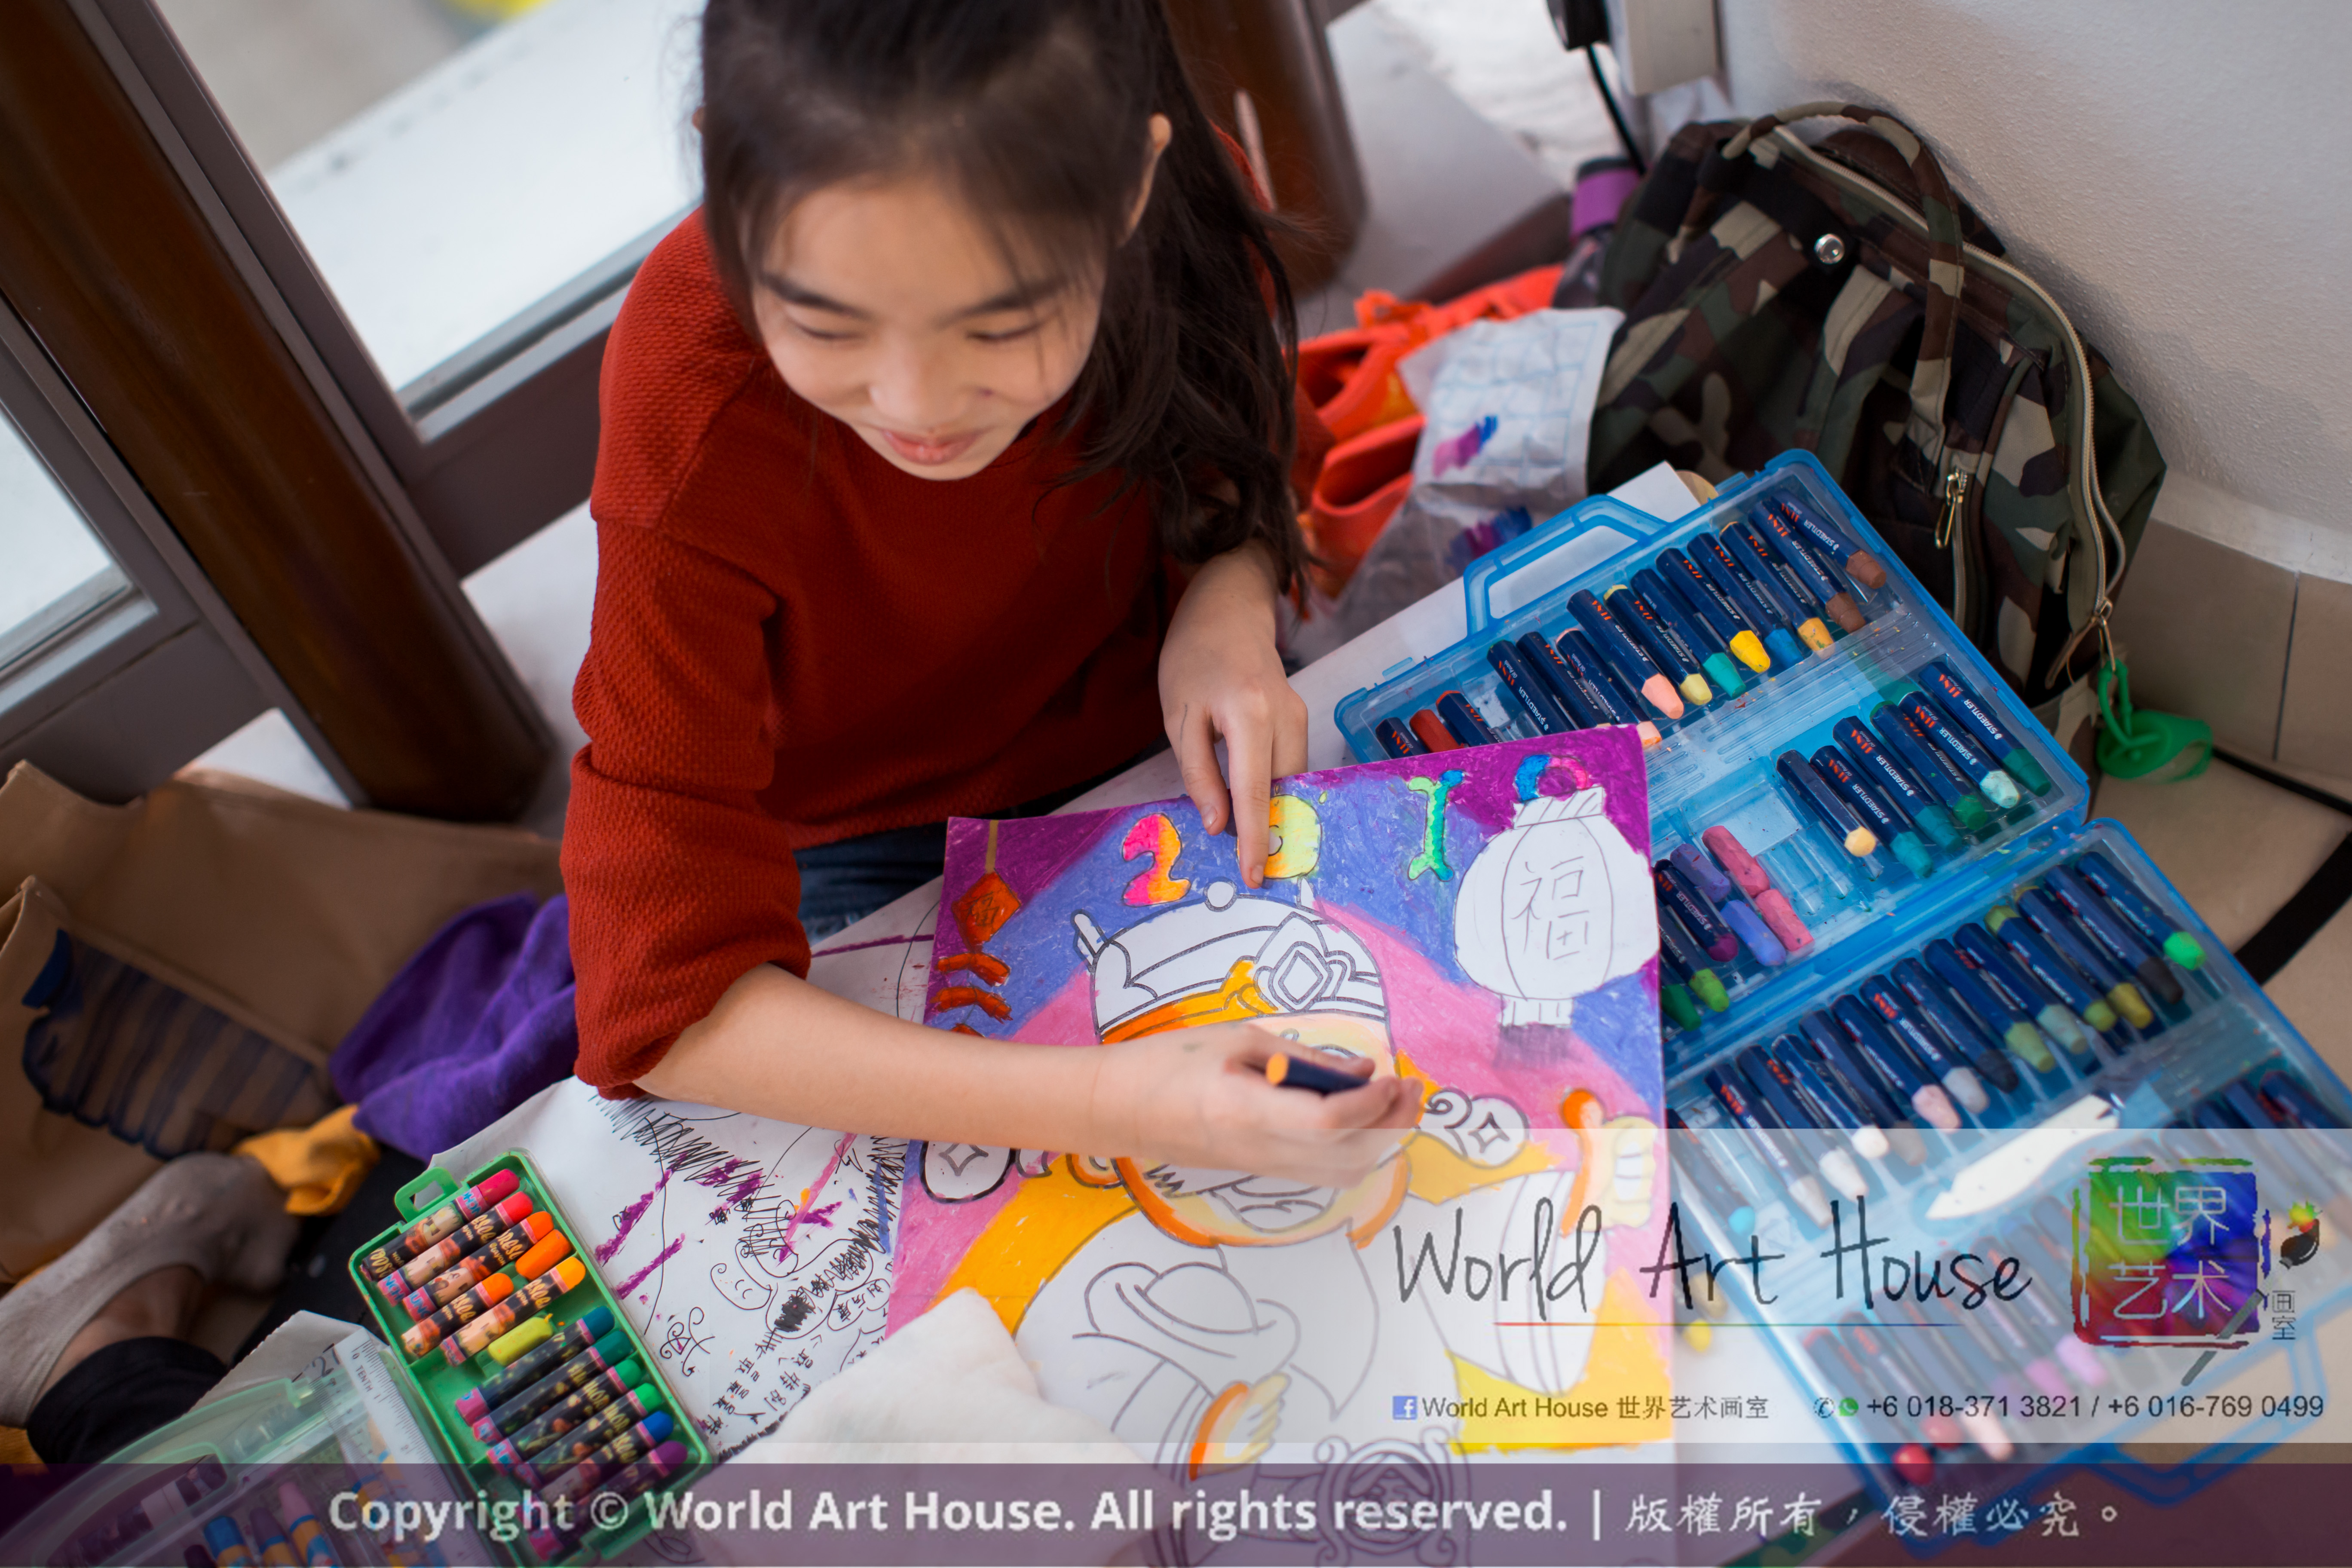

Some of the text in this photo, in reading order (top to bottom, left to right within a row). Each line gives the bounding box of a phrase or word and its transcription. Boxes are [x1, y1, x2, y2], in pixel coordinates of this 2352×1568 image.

[1802, 519, 1835, 547] STAEDTLER
[1791, 537, 1825, 578] STAEDTLER
[1503, 659, 1515, 673] Pastels
[1515, 686, 1547, 725] STAEDTLER
[1921, 704, 1933, 717] Pastels
[1963, 697, 1998, 736] STAEDTLER
[1399, 731, 1409, 743] Pastels
[1858, 729, 1871, 743] Pastels
[1939, 725, 1972, 763] STAEDTLER
[1835, 759, 1848, 773] Pastels
[1875, 753, 1910, 792] STAEDTLER
[1852, 782, 1885, 820] STAEDTLER
[1510, 856, 1590, 961] 福
[1675, 888, 1708, 926] STAEDTLER
[354, 1365, 375, 1392] TENTH
